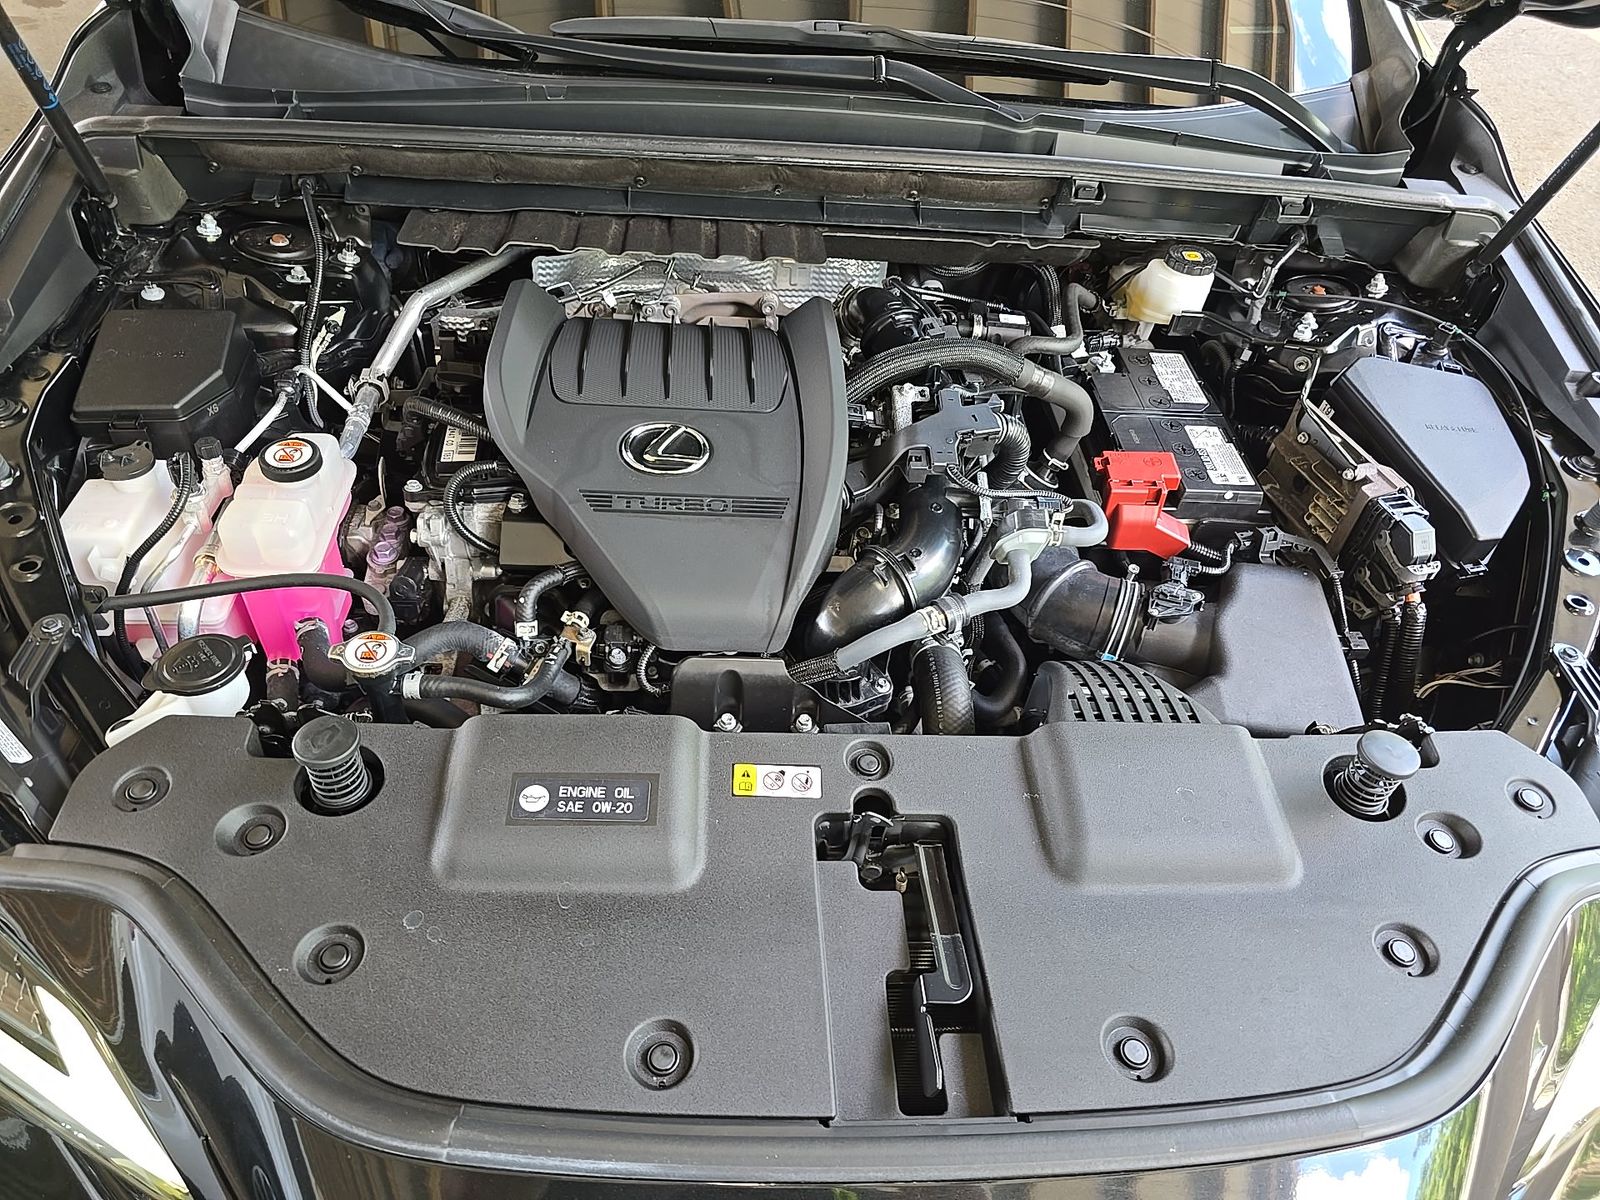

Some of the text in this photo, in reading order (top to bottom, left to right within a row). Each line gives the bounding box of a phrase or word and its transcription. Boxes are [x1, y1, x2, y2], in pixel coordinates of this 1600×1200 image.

[616, 495, 729, 512] TURBO
[558, 785, 635, 799] ENGINE OIL
[556, 800, 634, 814] SAE 0W-20
